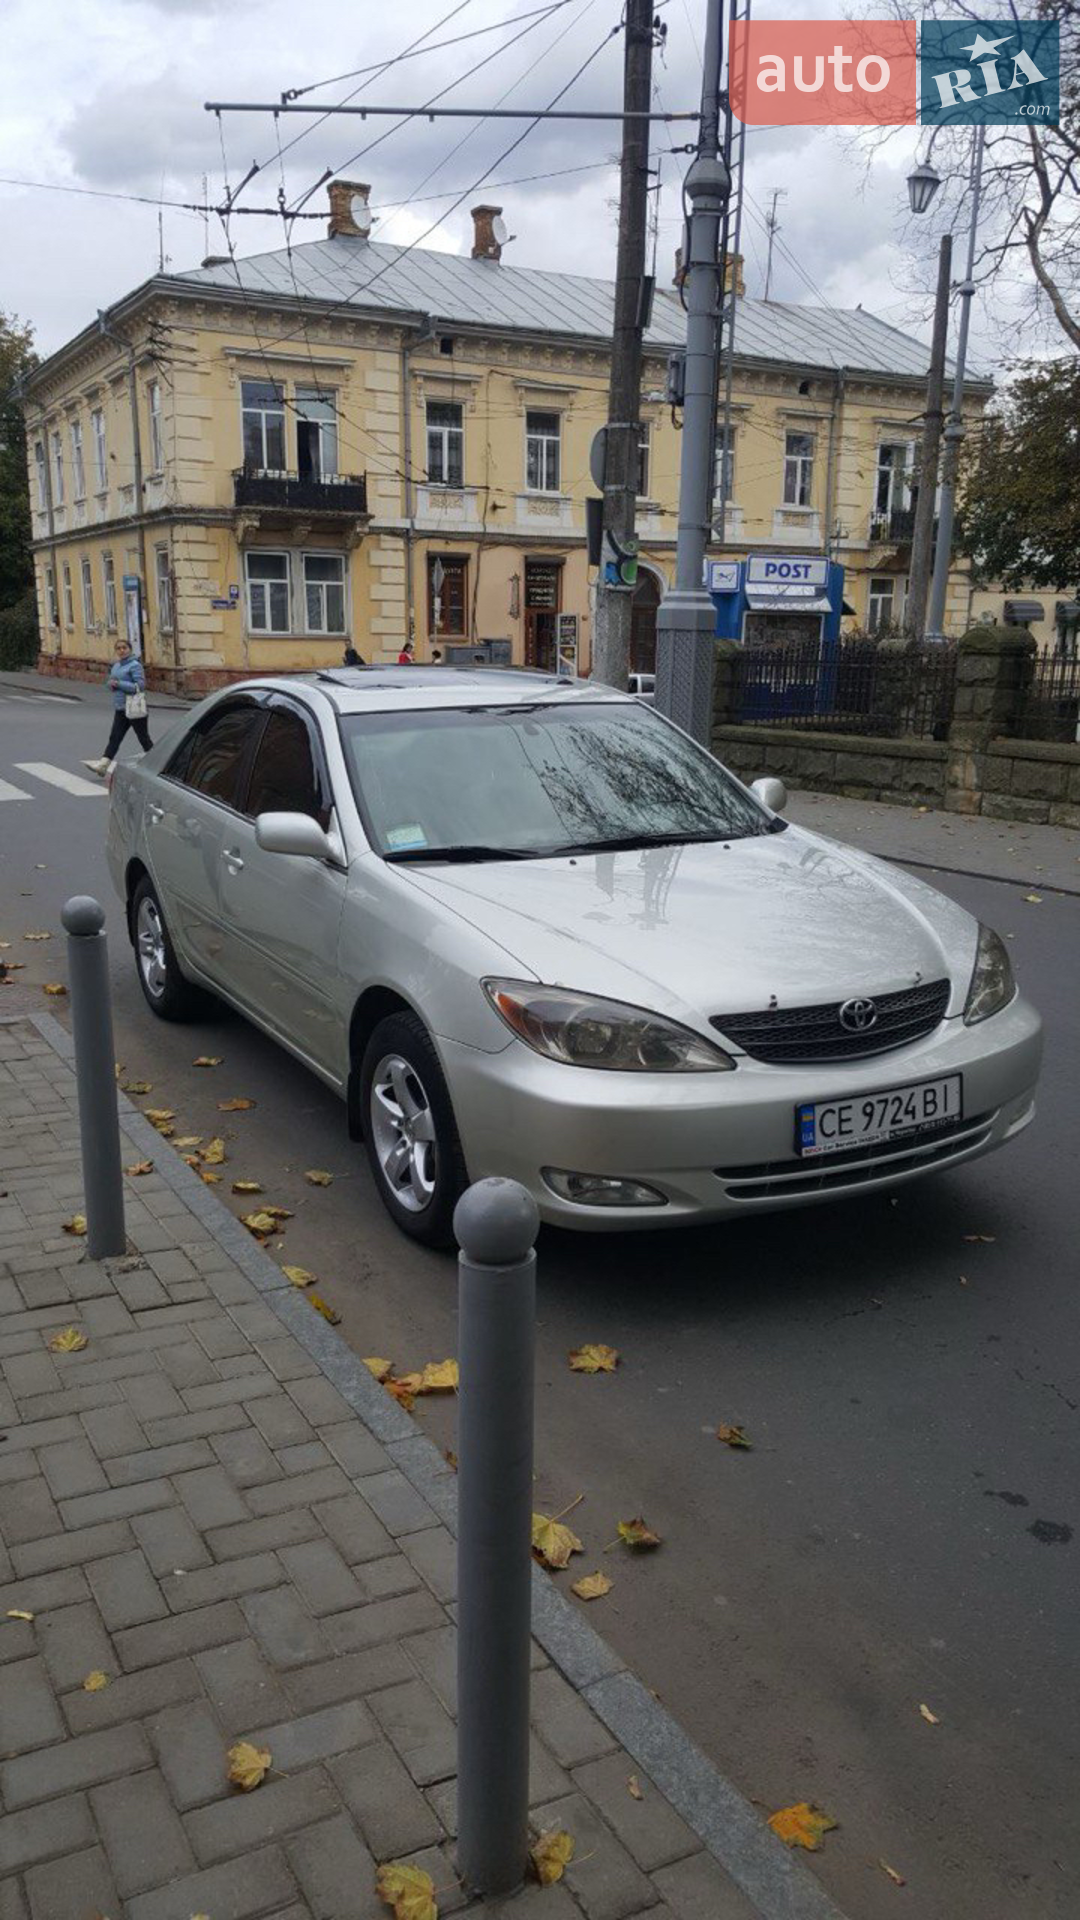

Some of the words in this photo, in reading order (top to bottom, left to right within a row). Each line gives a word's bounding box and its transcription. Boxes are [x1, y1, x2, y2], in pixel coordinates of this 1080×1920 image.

[765, 562, 812, 578] POST
[818, 1105, 854, 1138] CE
[862, 1092, 916, 1131] 9724
[923, 1084, 948, 1117] BI
[802, 1132, 814, 1142] UA
